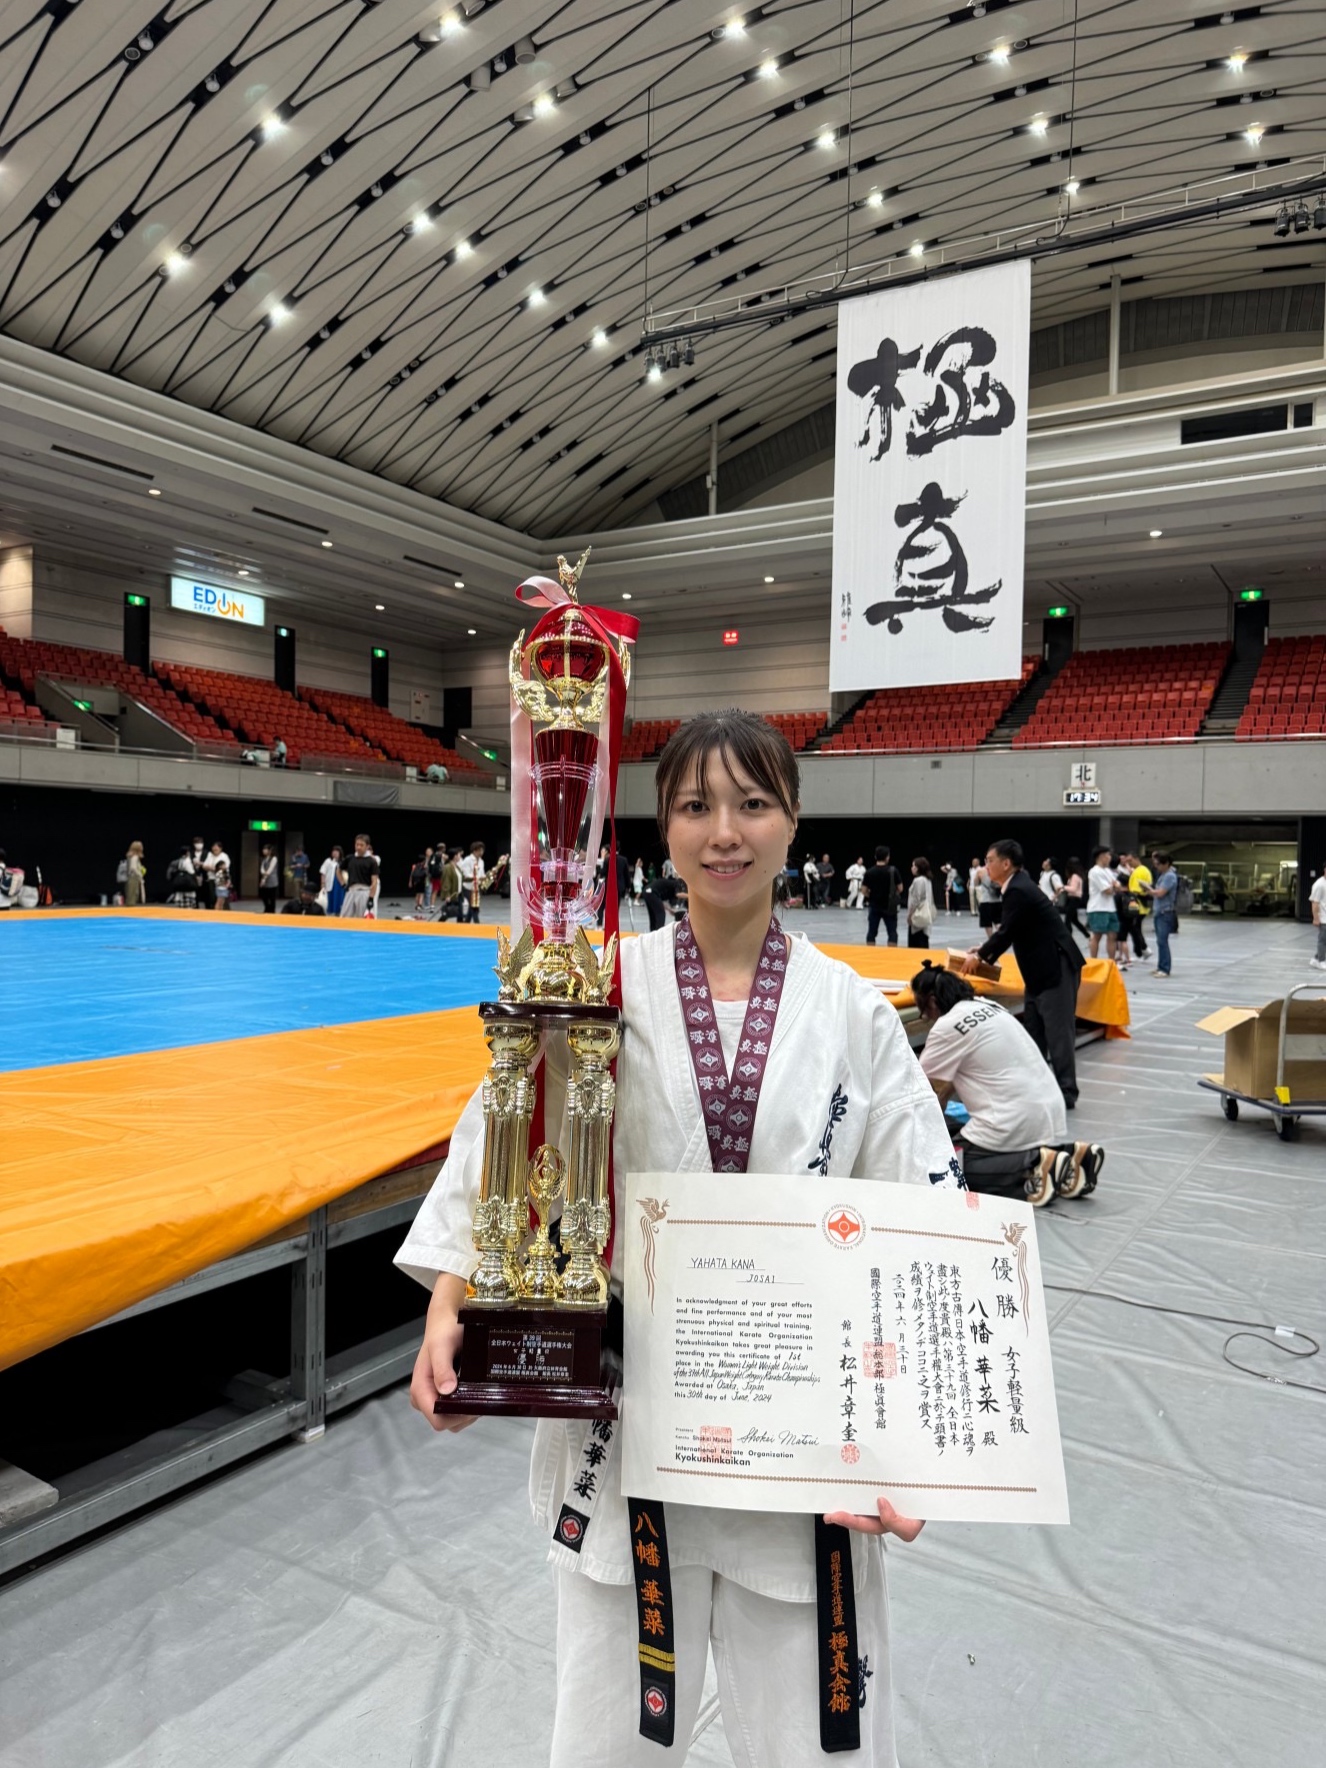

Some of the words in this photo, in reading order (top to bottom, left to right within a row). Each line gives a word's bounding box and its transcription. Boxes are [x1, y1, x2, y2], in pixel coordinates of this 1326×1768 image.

[194, 586, 244, 618] EDION
[1076, 765, 1092, 781] 北
[691, 1257, 727, 1269] YAHATA
[731, 1258, 755, 1269] KANA
[746, 1274, 775, 1283] JOSAI
[991, 1256, 1020, 1319] 優勝
[742, 1382, 764, 1394] Japan
[753, 1394, 772, 1402] 2024
[982, 1431, 998, 1446] 殿
[676, 1445, 716, 1453] International
[748, 1450, 794, 1458] Organization
[675, 1452, 750, 1466] Kyokushinkaikan
